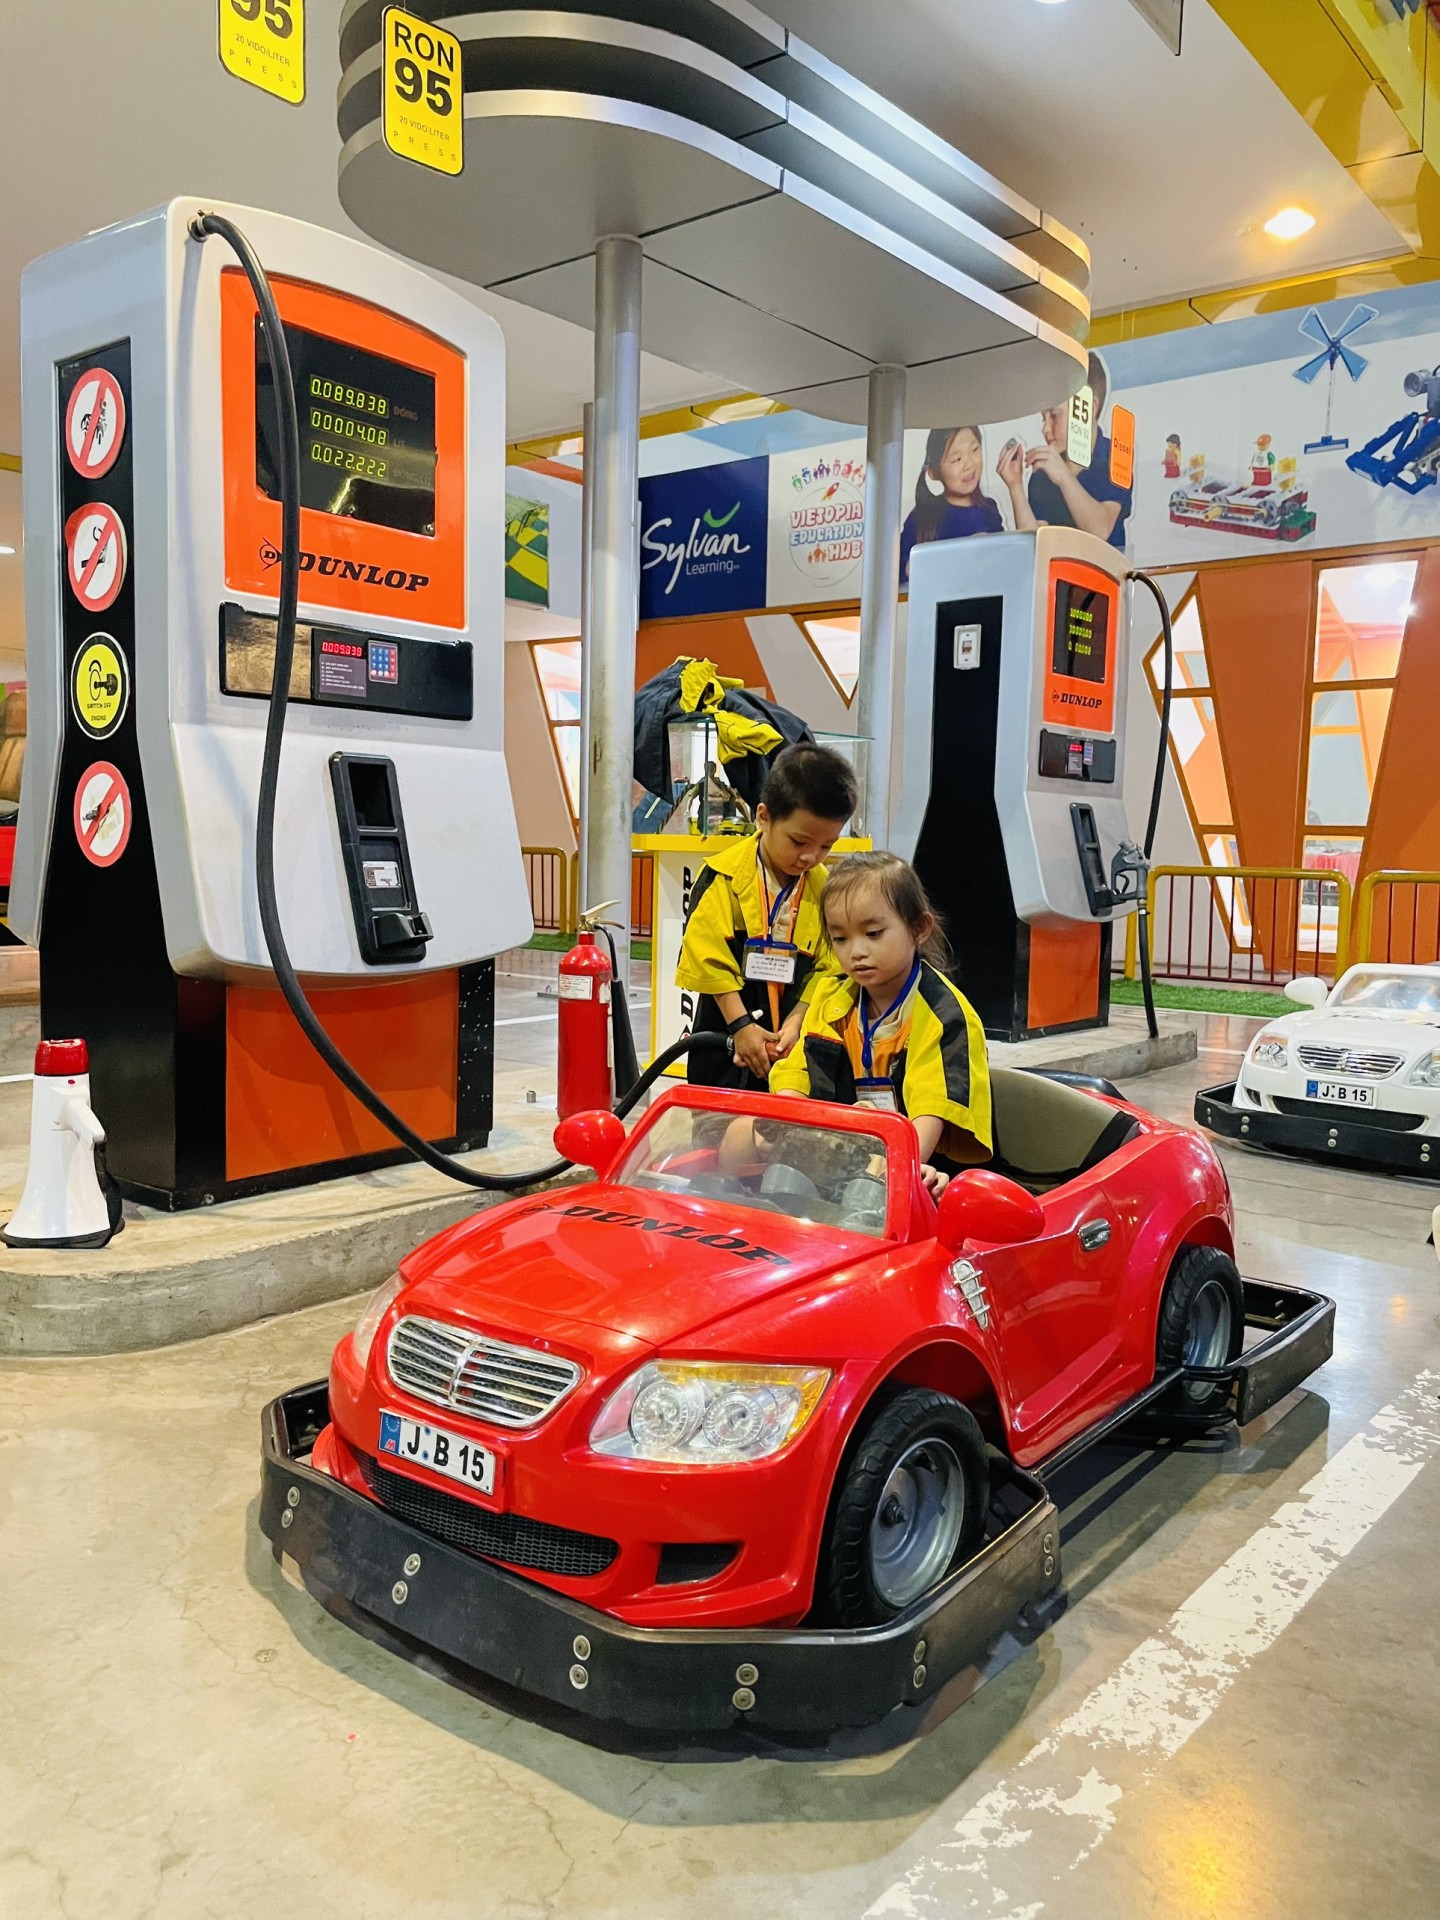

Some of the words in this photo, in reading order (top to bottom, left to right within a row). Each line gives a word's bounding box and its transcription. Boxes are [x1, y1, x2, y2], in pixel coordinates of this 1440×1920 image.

[235, 33, 245, 44] 20
[394, 20, 454, 72] RON
[394, 57, 453, 117] 95
[399, 115, 408, 125] 20
[1072, 394, 1089, 424] E5
[1113, 437, 1131, 455] Diesel
[790, 501, 863, 529] VIETOPIA
[790, 522, 864, 547] EDUCATION
[641, 517, 751, 595] Sylvan
[828, 540, 863, 562] HUB
[297, 551, 430, 592] DUNLOP
[686, 557, 734, 576] Learning
[1060, 692, 1102, 708] DUNLOP
[1352, 1089, 1367, 1102] 15
[551, 1205, 792, 1266] DUNLOP
[459, 1444, 485, 1482] 15
